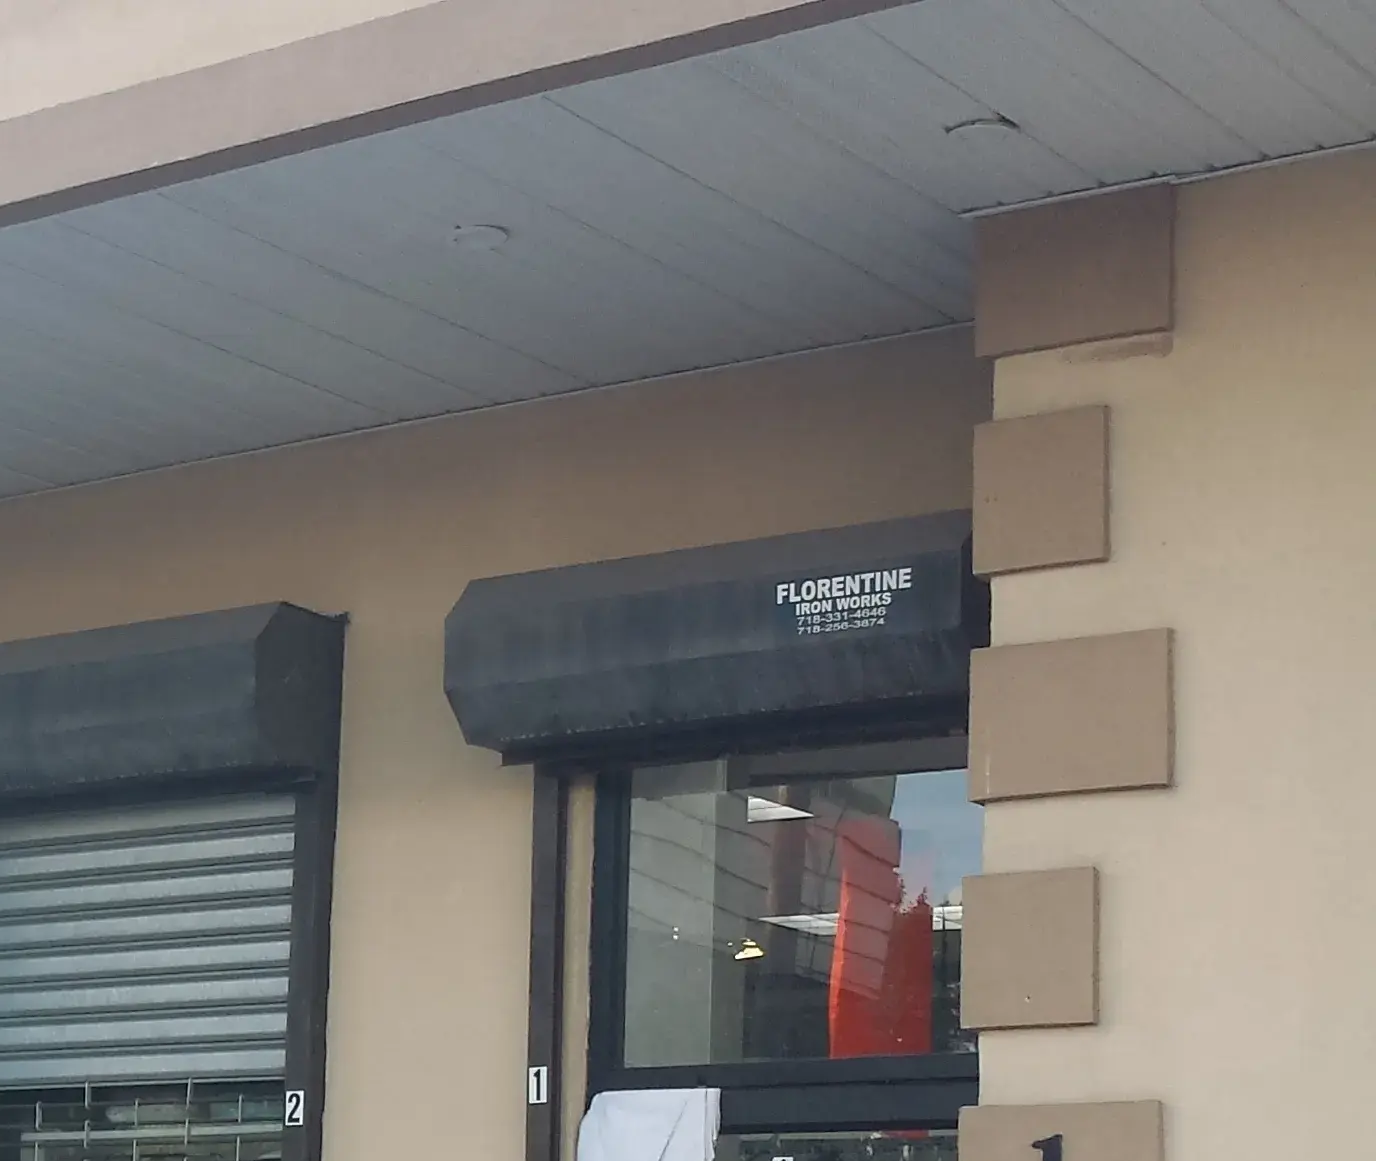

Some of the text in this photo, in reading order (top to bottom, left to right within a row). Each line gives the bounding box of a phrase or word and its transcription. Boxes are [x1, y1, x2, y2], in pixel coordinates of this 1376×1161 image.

[776, 567, 912, 605] FLORENTINE
[795, 592, 892, 616] IRON WORKS
[797, 606, 887, 626] 718-331-4646
[797, 617, 886, 635] 718-256-3874
[287, 1093, 301, 1123] 2
